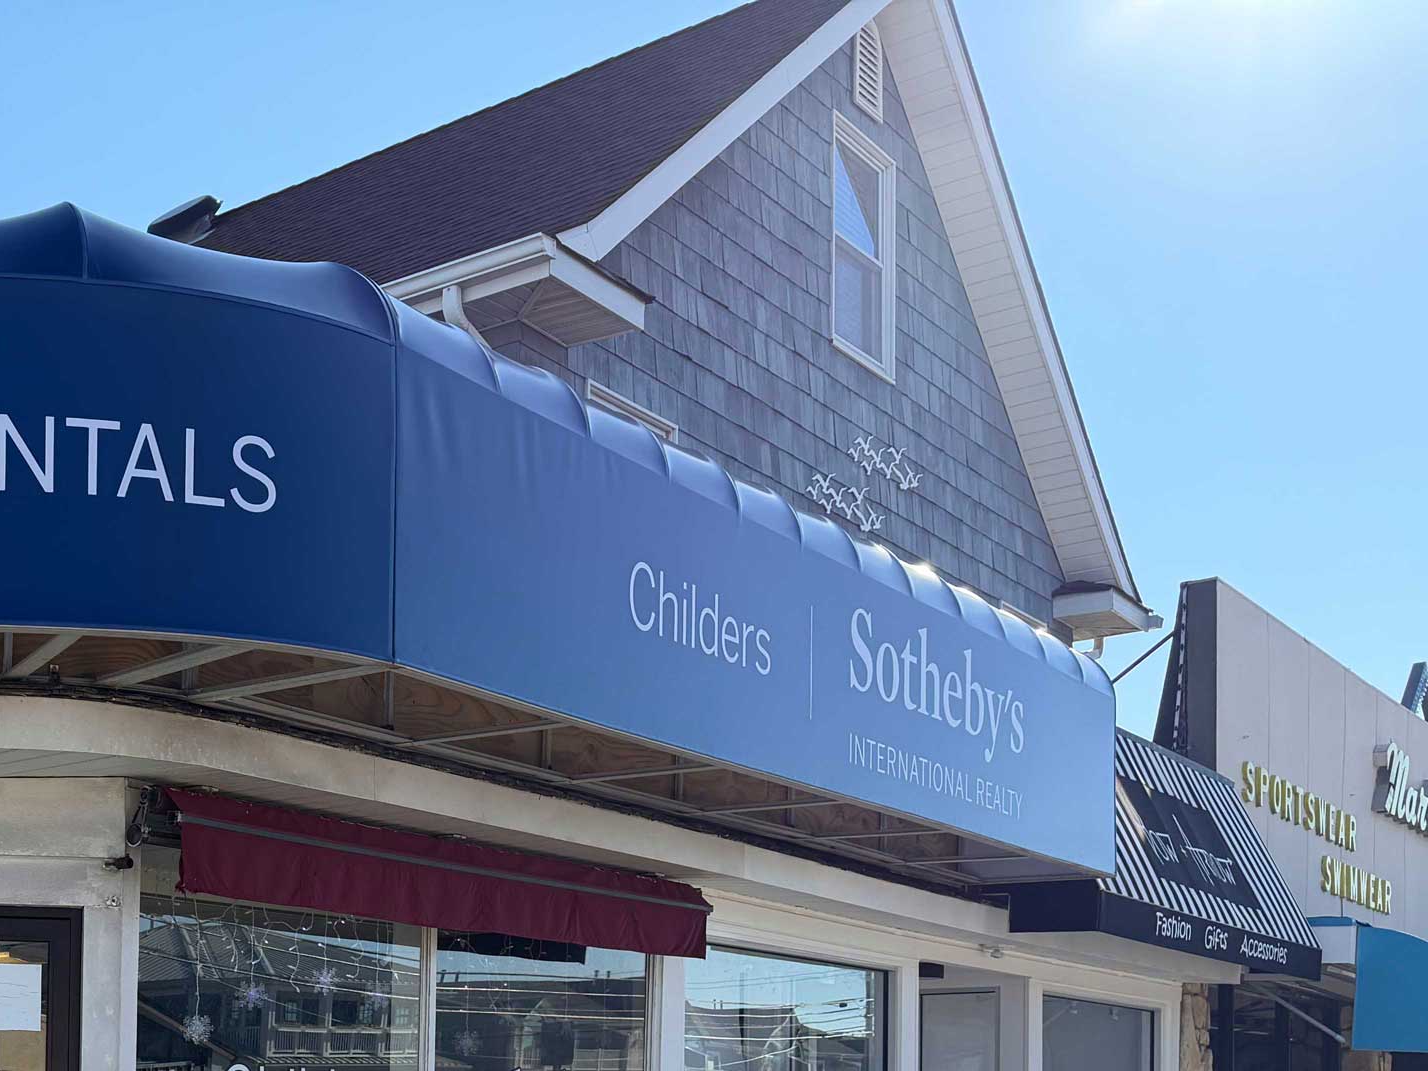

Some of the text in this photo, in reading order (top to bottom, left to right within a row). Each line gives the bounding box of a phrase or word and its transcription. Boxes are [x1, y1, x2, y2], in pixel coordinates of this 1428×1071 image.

[628, 560, 773, 676] Childers
[849, 607, 1026, 763] Sotheby's
[848, 732, 1024, 821] INTERNATIONAL REALTY
[1242, 760, 1358, 853] SPORTSWEAR
[1322, 855, 1392, 916] SWIMWEAR
[1155, 911, 1289, 966] Fashion Gifts Accessories
